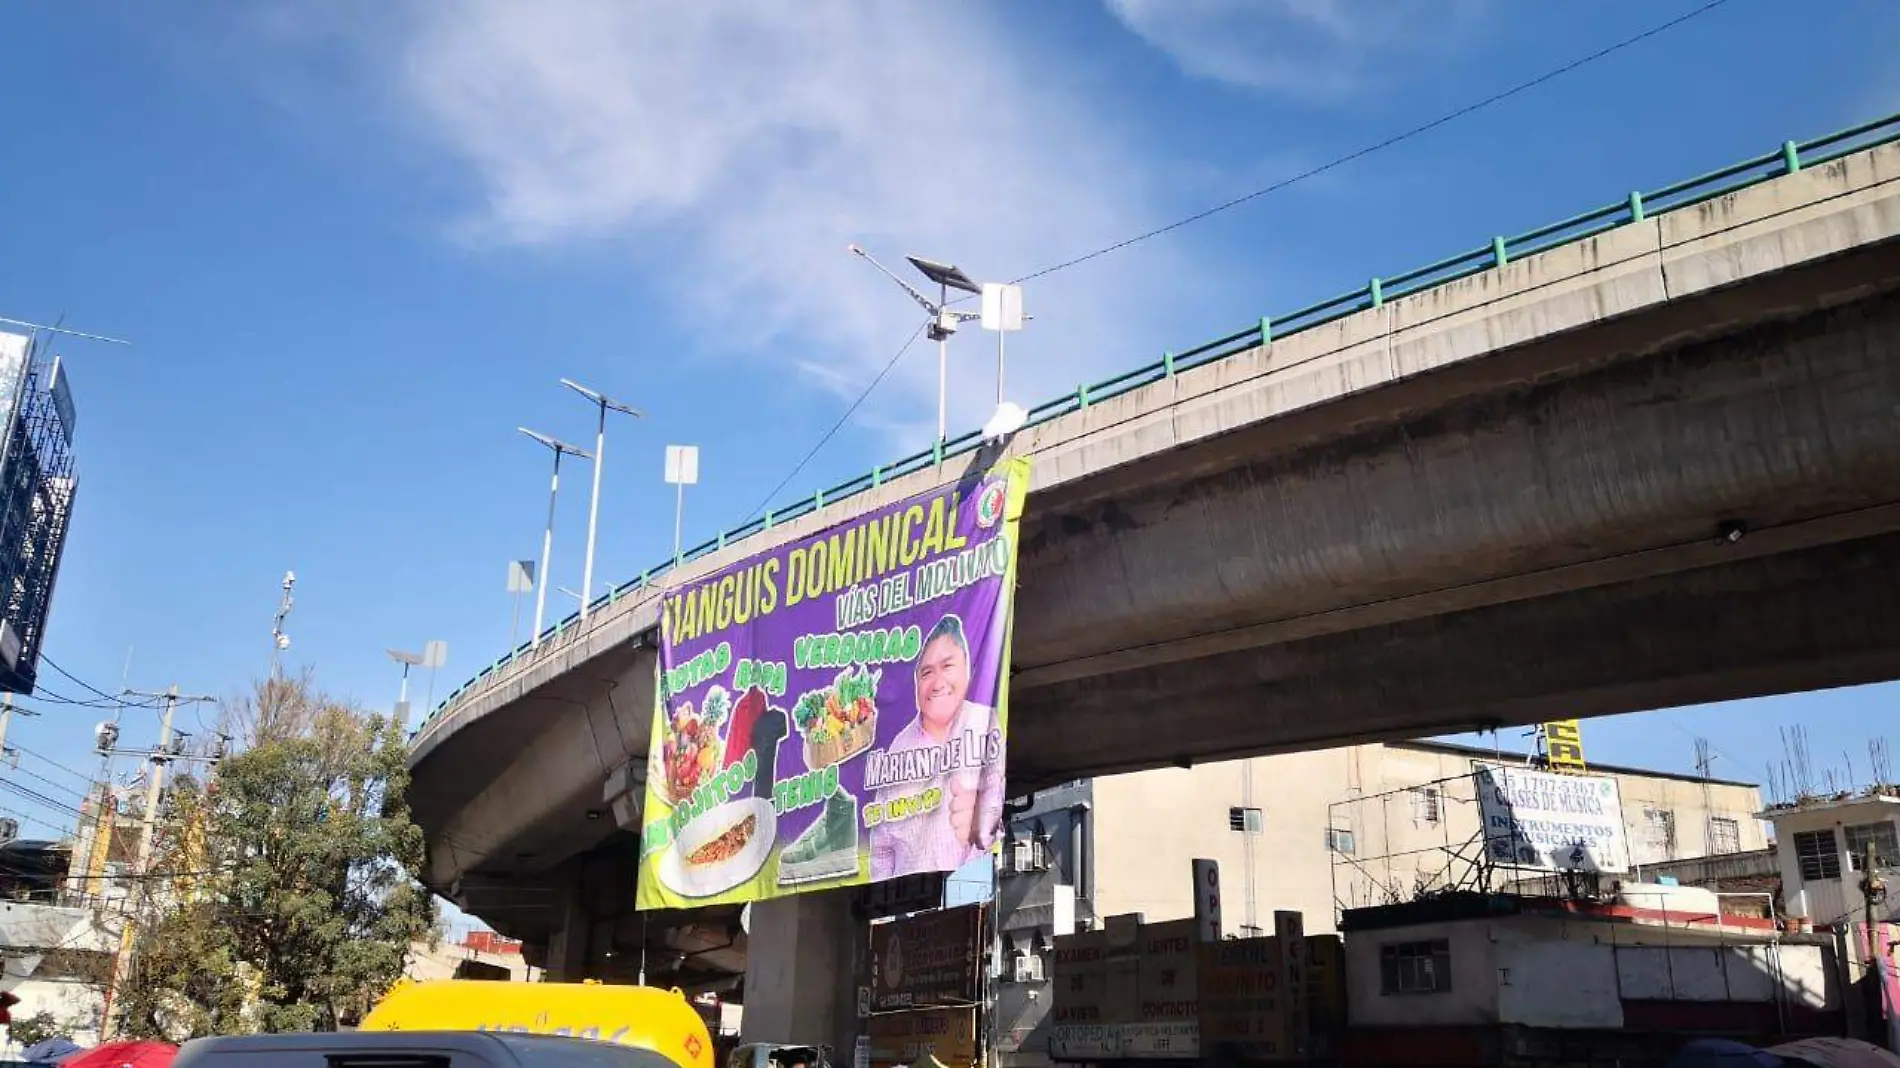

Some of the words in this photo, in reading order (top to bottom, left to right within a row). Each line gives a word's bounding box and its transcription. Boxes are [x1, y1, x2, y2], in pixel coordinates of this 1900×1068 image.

[786, 494, 965, 605] DOMINICAL
[878, 572, 913, 617] DEL
[795, 627, 921, 666] VERDURAS
[662, 642, 731, 694] UTAS
[963, 728, 1001, 768] LS
[642, 749, 758, 852] OJITOS
[772, 763, 840, 816] TENIS
[1490, 815, 1613, 838] INSTRUMENTOS
[1512, 829, 1598, 849] MUSICALES
[1142, 1001, 1199, 1017] CONTACTO
